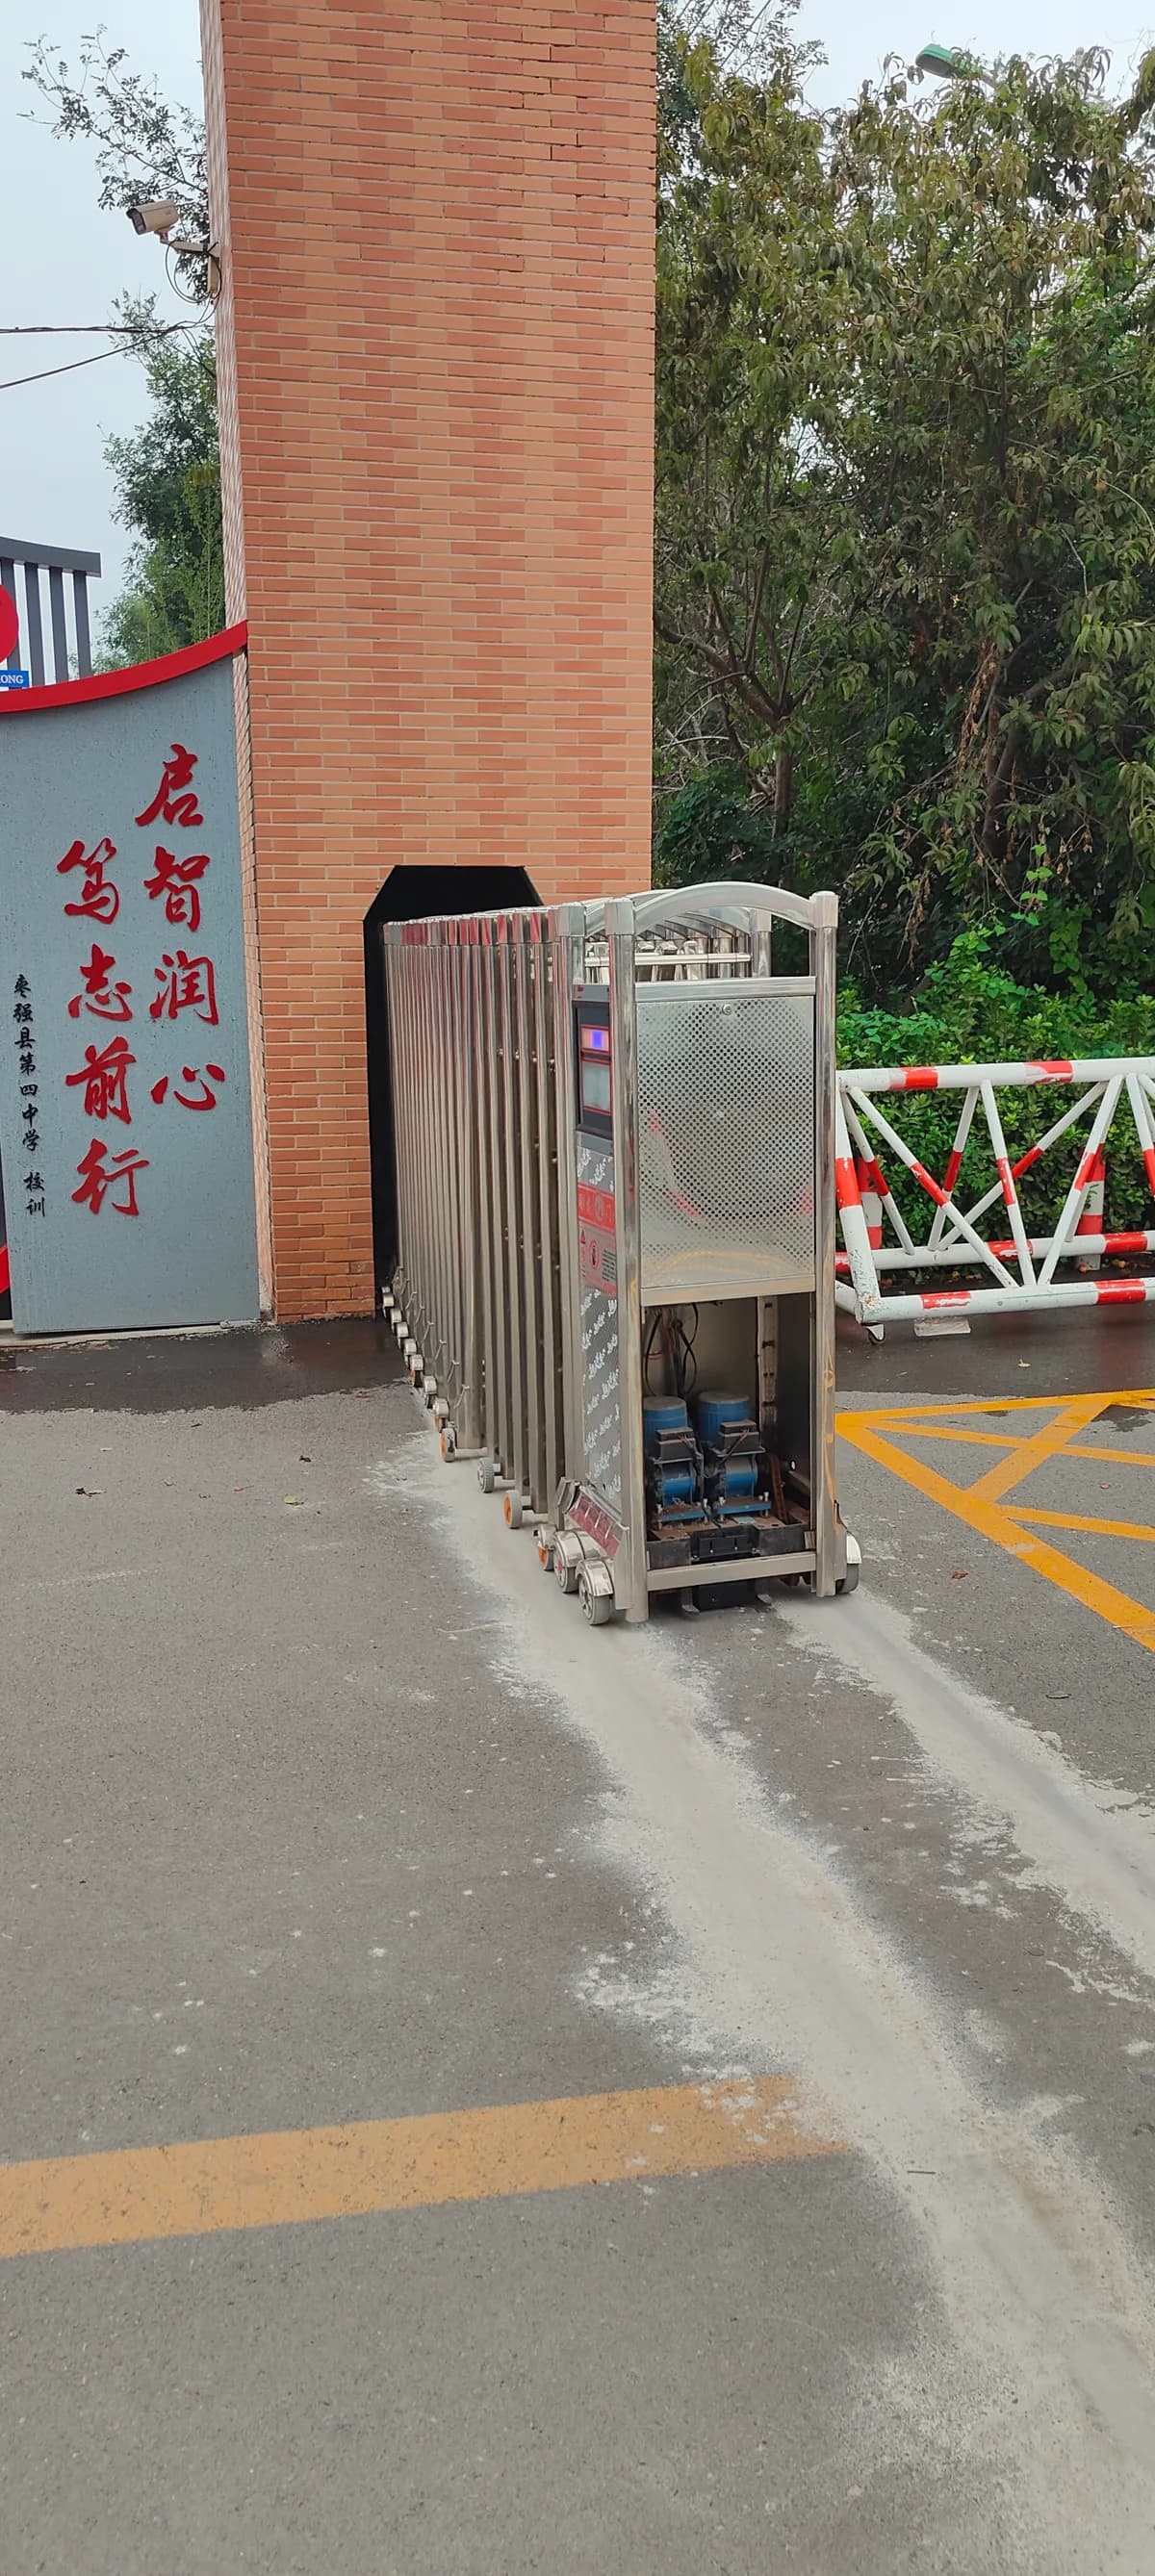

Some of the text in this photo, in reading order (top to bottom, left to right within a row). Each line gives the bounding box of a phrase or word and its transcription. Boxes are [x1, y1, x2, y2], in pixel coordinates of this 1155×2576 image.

[0, 674, 24, 684] ONG
[57, 837, 150, 1216] 笃志前行
[136, 744, 225, 1110] 启智润心
[13, 974, 45, 1217] 枣强县第四中学 校训
